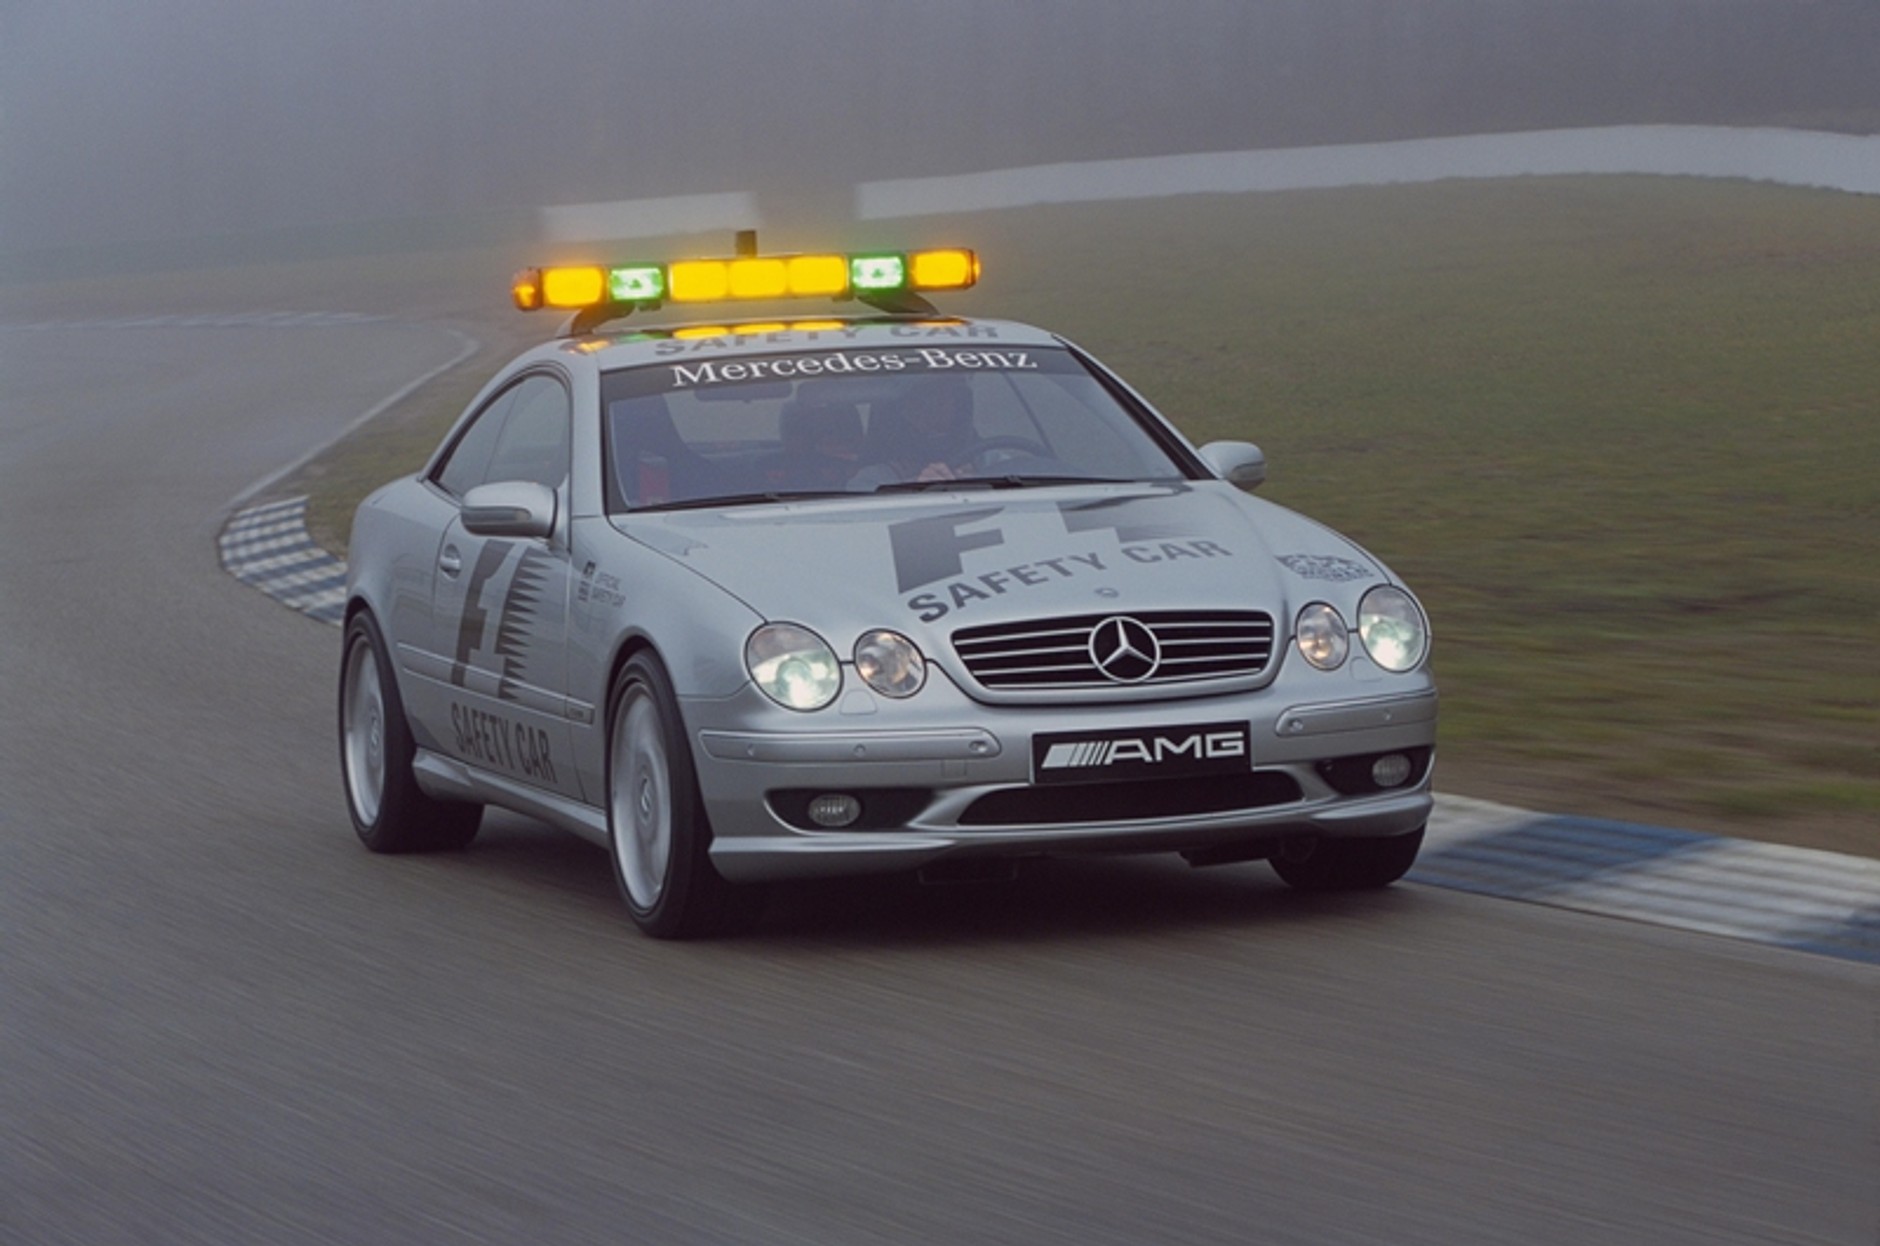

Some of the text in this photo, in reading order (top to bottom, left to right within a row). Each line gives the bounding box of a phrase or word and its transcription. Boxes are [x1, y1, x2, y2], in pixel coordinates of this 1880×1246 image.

[890, 323, 998, 339] CAR
[671, 346, 1039, 388] Mercedes-Benz
[907, 540, 1233, 623] SAFETY CAR
[450, 701, 559, 784] SAFETY CAR
[1103, 731, 1245, 766] AMG
